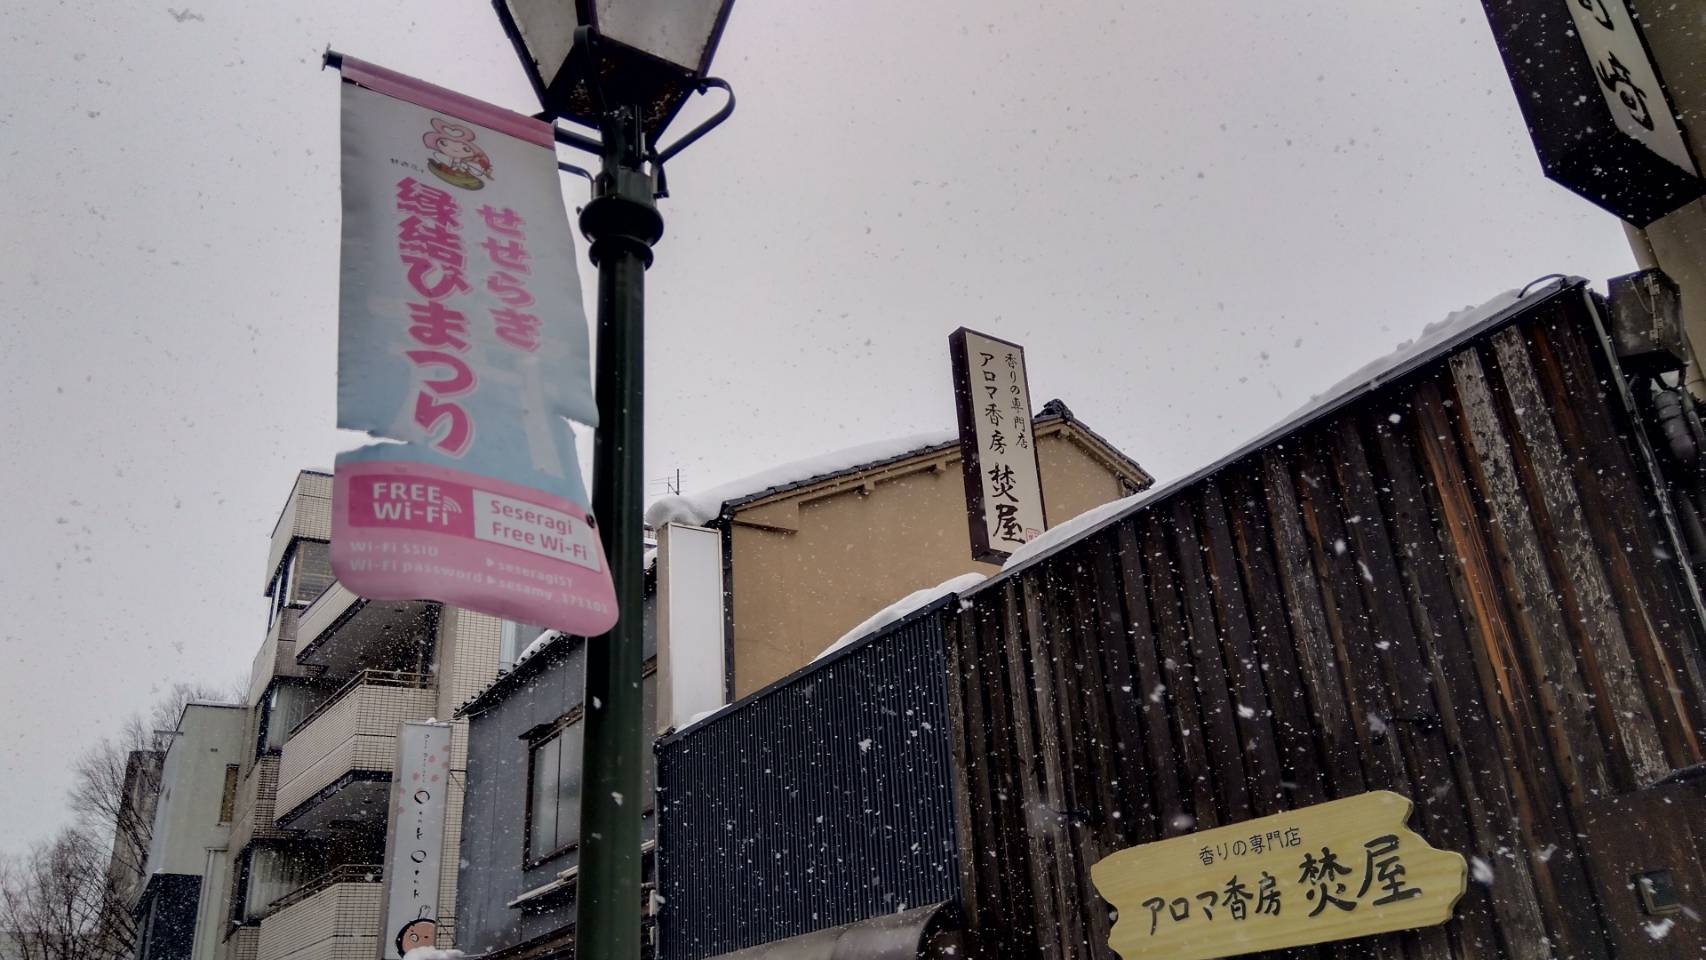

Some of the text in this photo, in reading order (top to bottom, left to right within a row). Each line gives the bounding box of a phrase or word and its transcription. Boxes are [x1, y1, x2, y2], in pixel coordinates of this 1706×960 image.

[475, 203, 543, 351] せせらぎ
[396, 176, 478, 457] 縁結びまつり
[1005, 353, 1028, 449] 香りの専門店
[979, 351, 1026, 544] アロマ香房 焚屋
[372, 481, 441, 505] FREE
[372, 501, 449, 526] Wi-Fi
[490, 500, 572, 535] Seseragi
[491, 521, 588, 560] Free Wi-Fi
[401, 560, 483, 584] password
[1199, 826, 1302, 866] 香りの専門店
[1142, 834, 1424, 936] アロマ香房 焚屋
